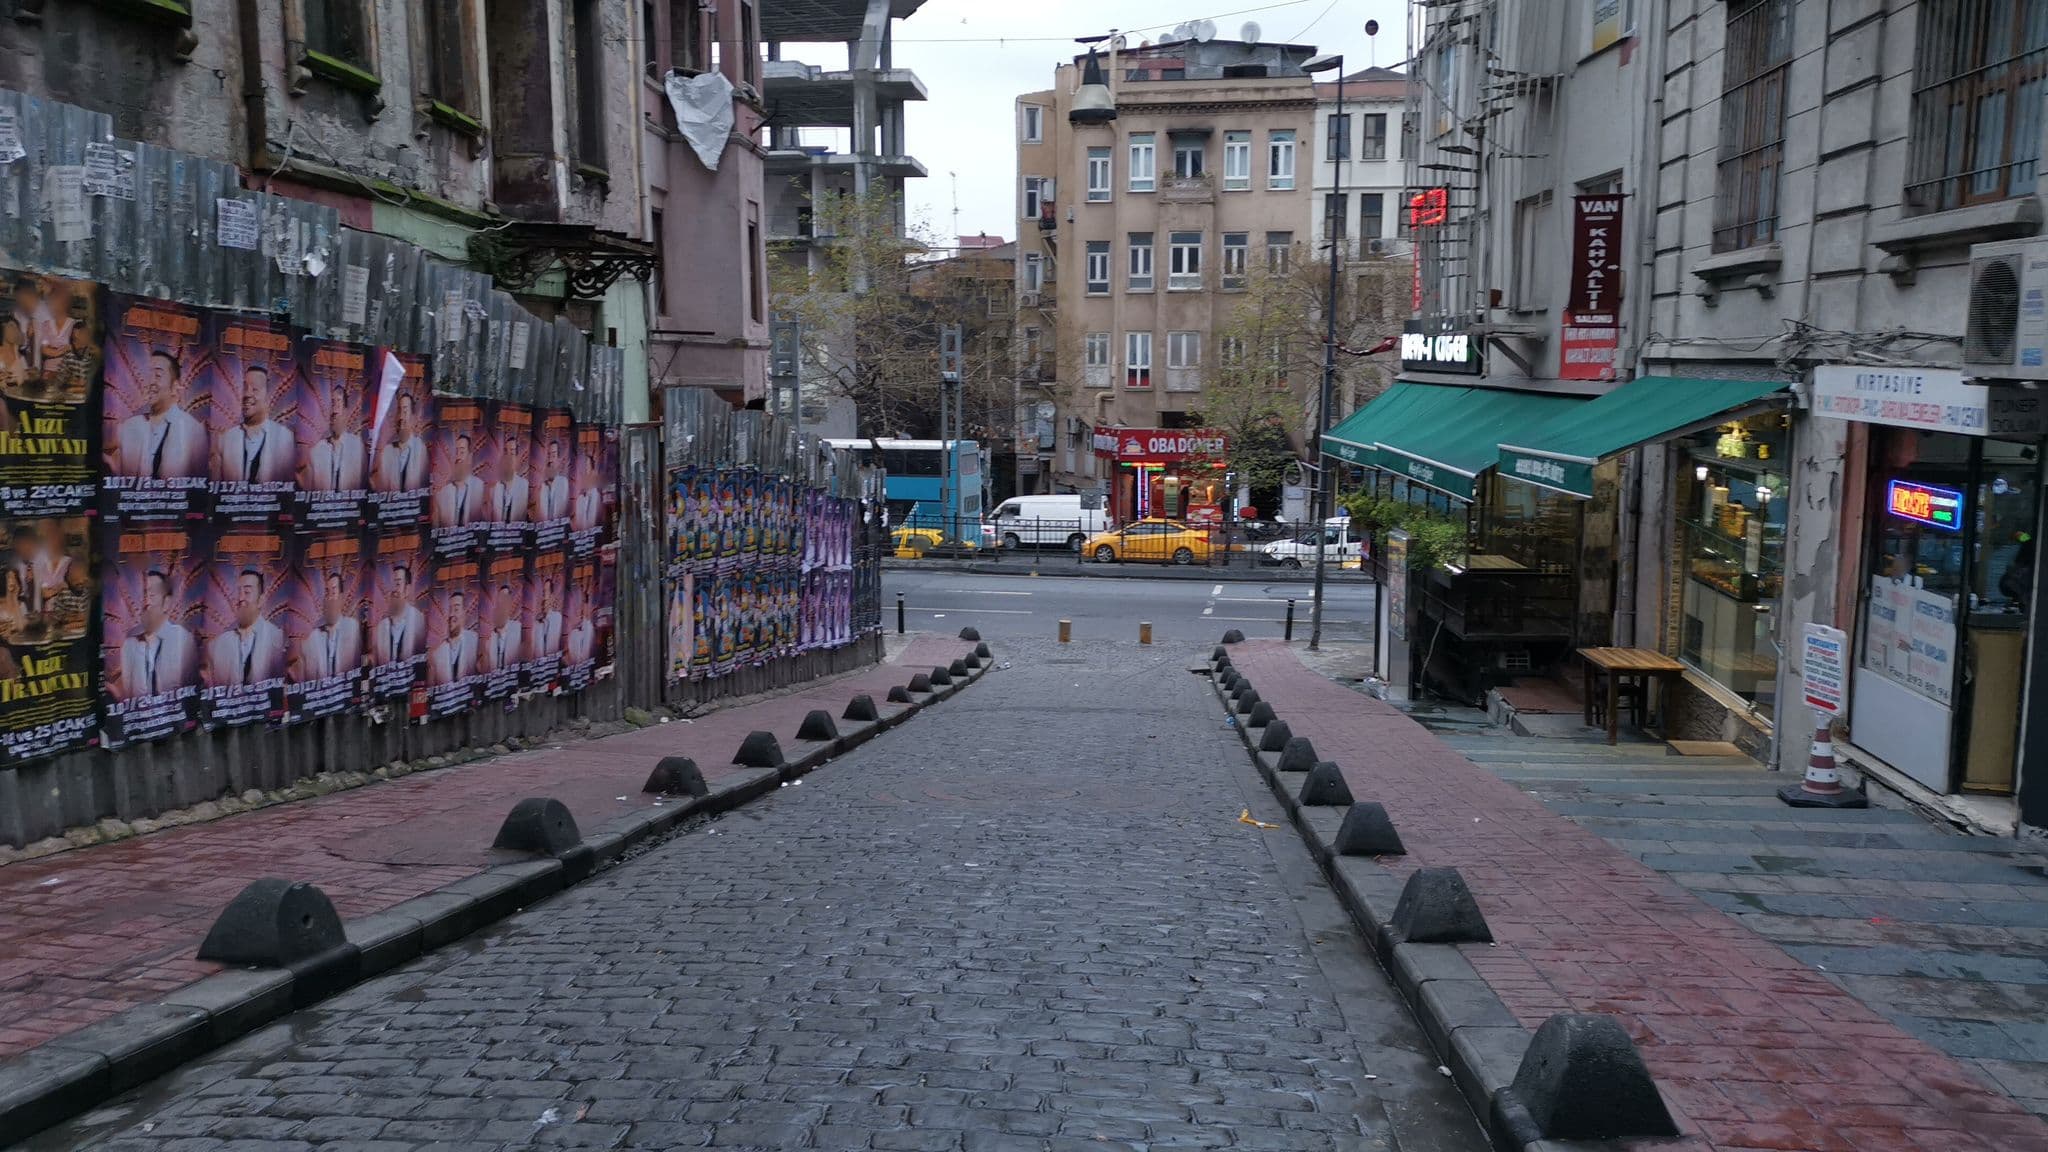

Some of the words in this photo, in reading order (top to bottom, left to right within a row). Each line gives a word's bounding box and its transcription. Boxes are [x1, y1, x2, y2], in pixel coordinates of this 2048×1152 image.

[1580, 200, 1618, 213] VAN
[1587, 228, 1609, 310] KAHVALTI
[1148, 437, 1176, 454] OBA
